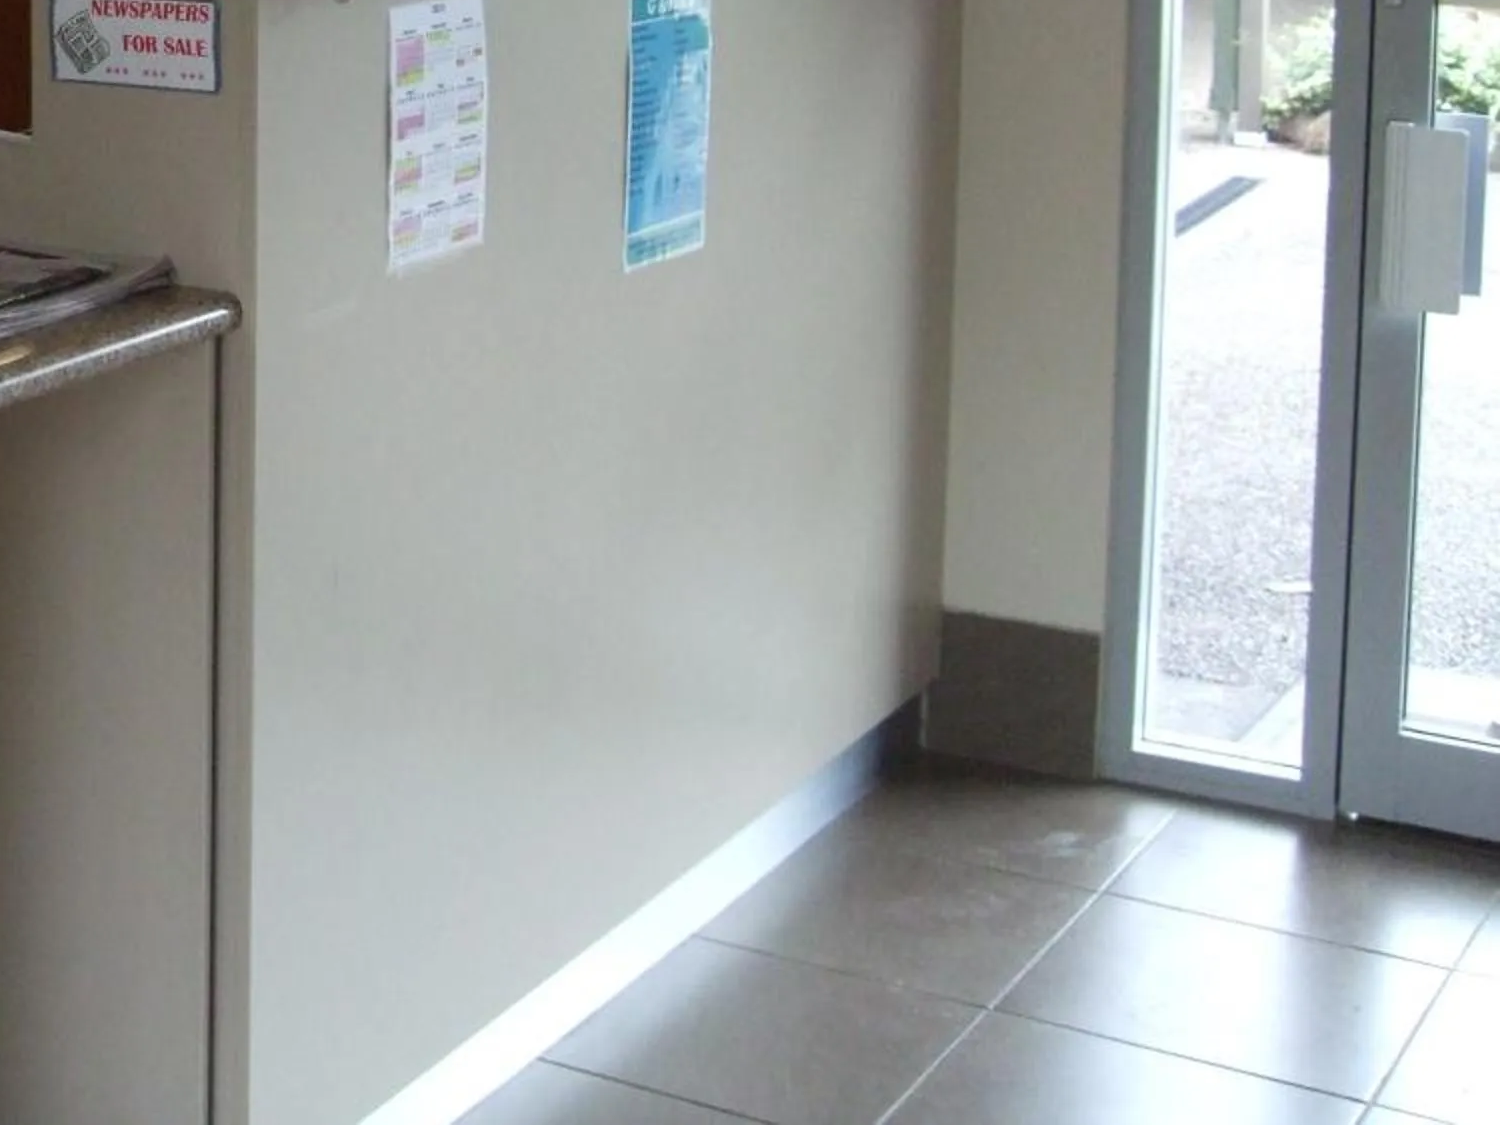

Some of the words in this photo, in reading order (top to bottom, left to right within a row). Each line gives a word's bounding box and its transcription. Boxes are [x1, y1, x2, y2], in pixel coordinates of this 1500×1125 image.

[91, 0, 209, 24] NEWSPAPERS
[122, 34, 157, 53] FOR
[163, 37, 208, 57] SALE
